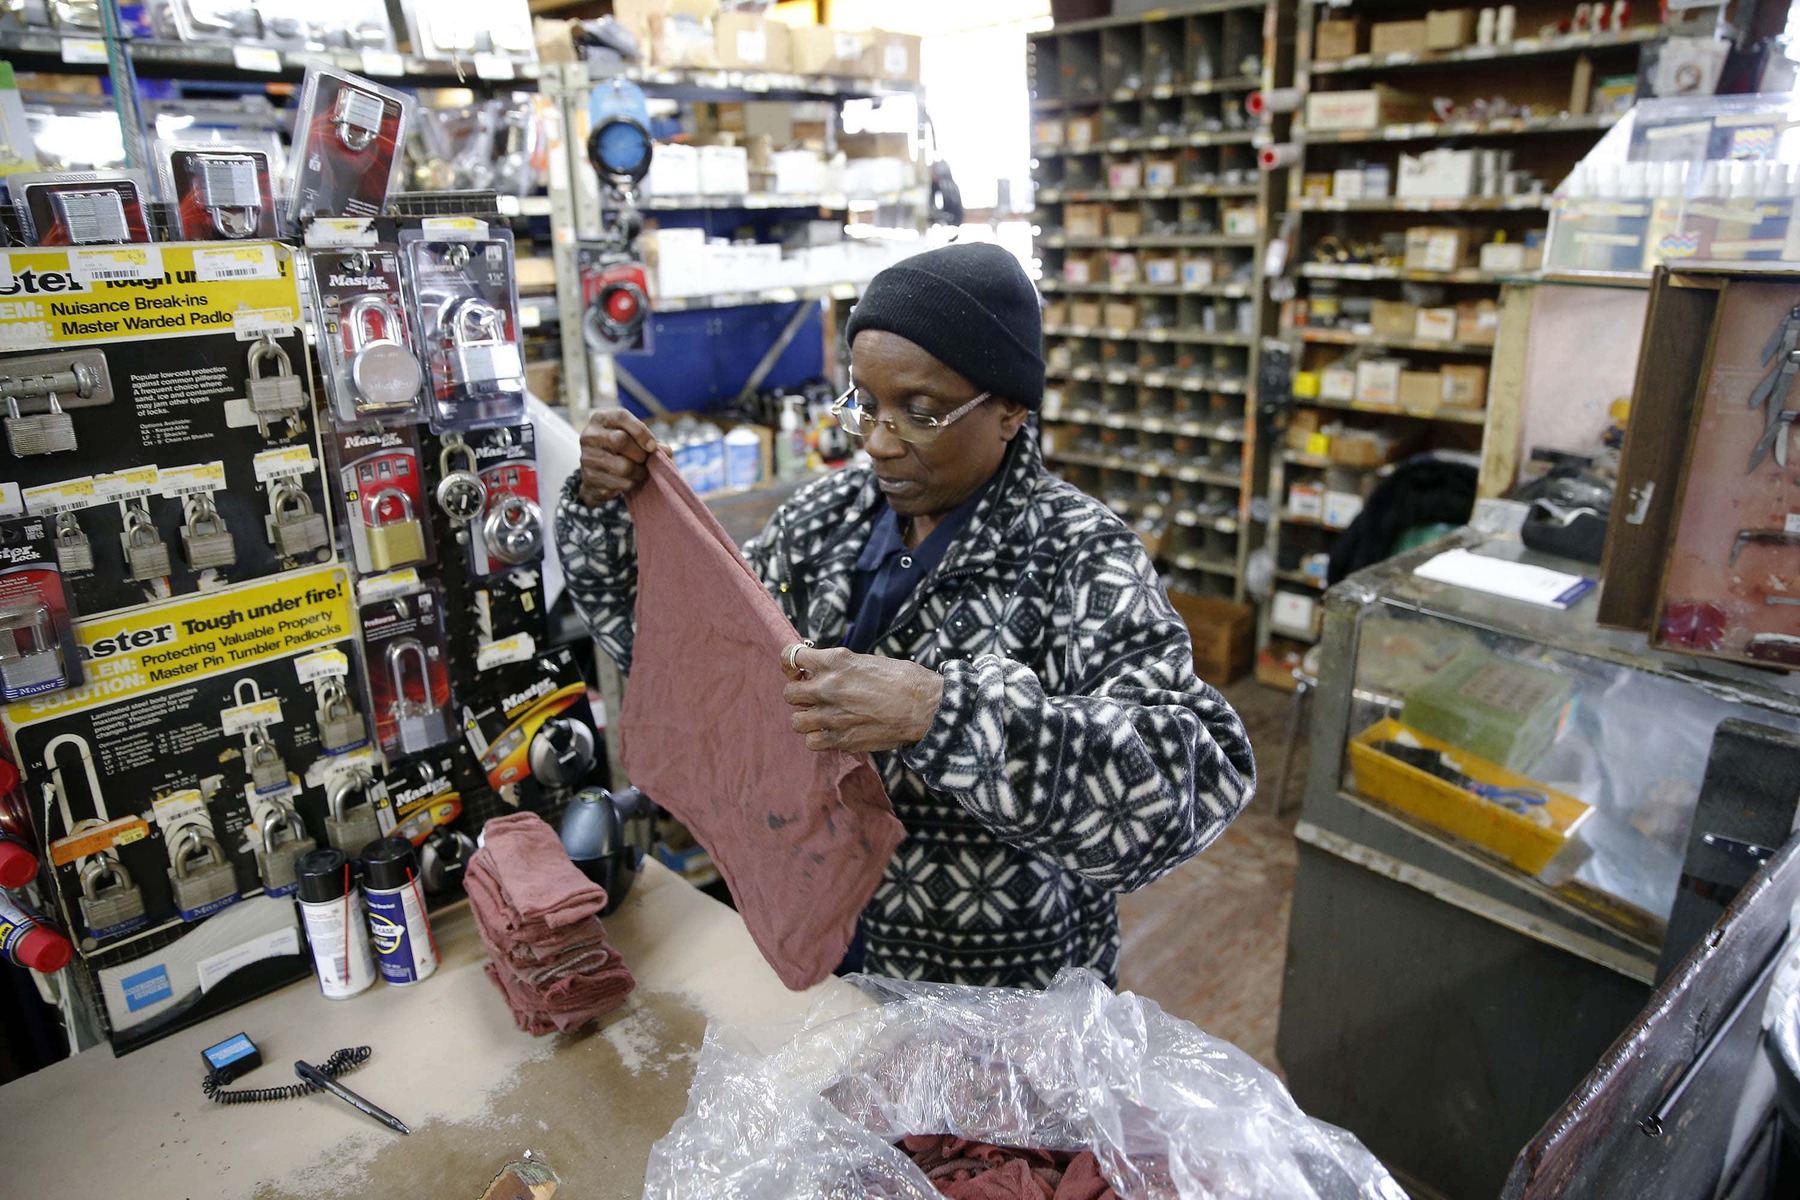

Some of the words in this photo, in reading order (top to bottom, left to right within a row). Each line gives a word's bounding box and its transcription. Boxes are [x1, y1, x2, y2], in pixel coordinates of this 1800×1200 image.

[329, 274, 385, 288] Master
[51, 301, 130, 316] Nuisance
[134, 294, 208, 310] Break-ins
[62, 320, 119, 335] Master
[123, 314, 186, 331] Warded
[190, 310, 233, 325] Padlo
[130, 373, 159, 382] Popular
[191, 366, 227, 376] protection
[132, 380, 160, 389] against
[161, 376, 194, 385] common
[140, 386, 173, 395] frequent
[173, 383, 199, 391] choice
[170, 391, 185, 399] and
[186, 386, 235, 397] contaminants
[136, 402, 153, 410] may
[153, 401, 168, 409] jam
[169, 398, 189, 406] other
[190, 397, 210, 405] types
[146, 408, 170, 416] locks.
[77, 624, 171, 661] aster
[182, 610, 244, 635] Tough
[248, 597, 302, 619] under
[305, 584, 343, 605] fire!
[142, 640, 216, 667] Protecting
[219, 626, 275, 647] Valuable
[278, 610, 333, 632] Property
[30, 674, 146, 713] SOLUTION:
[149, 661, 199, 682] Master
[203, 655, 225, 669] Pin
[228, 640, 282, 661] Tumbler
[285, 623, 342, 647] Padlocks
[20, 682, 56, 696] Master
[91, 706, 130, 720] Laminated
[131, 701, 149, 710] steel
[149, 696, 167, 705] body
[168, 688, 198, 700] provides
[93, 713, 129, 727] maximum
[130, 703, 167, 716] protection
[178, 695, 194, 704] your
[94, 721, 127, 734] property.
[129, 709, 168, 722] Thousands
[96, 727, 128, 739] changes
[194, 896, 234, 916] Master
